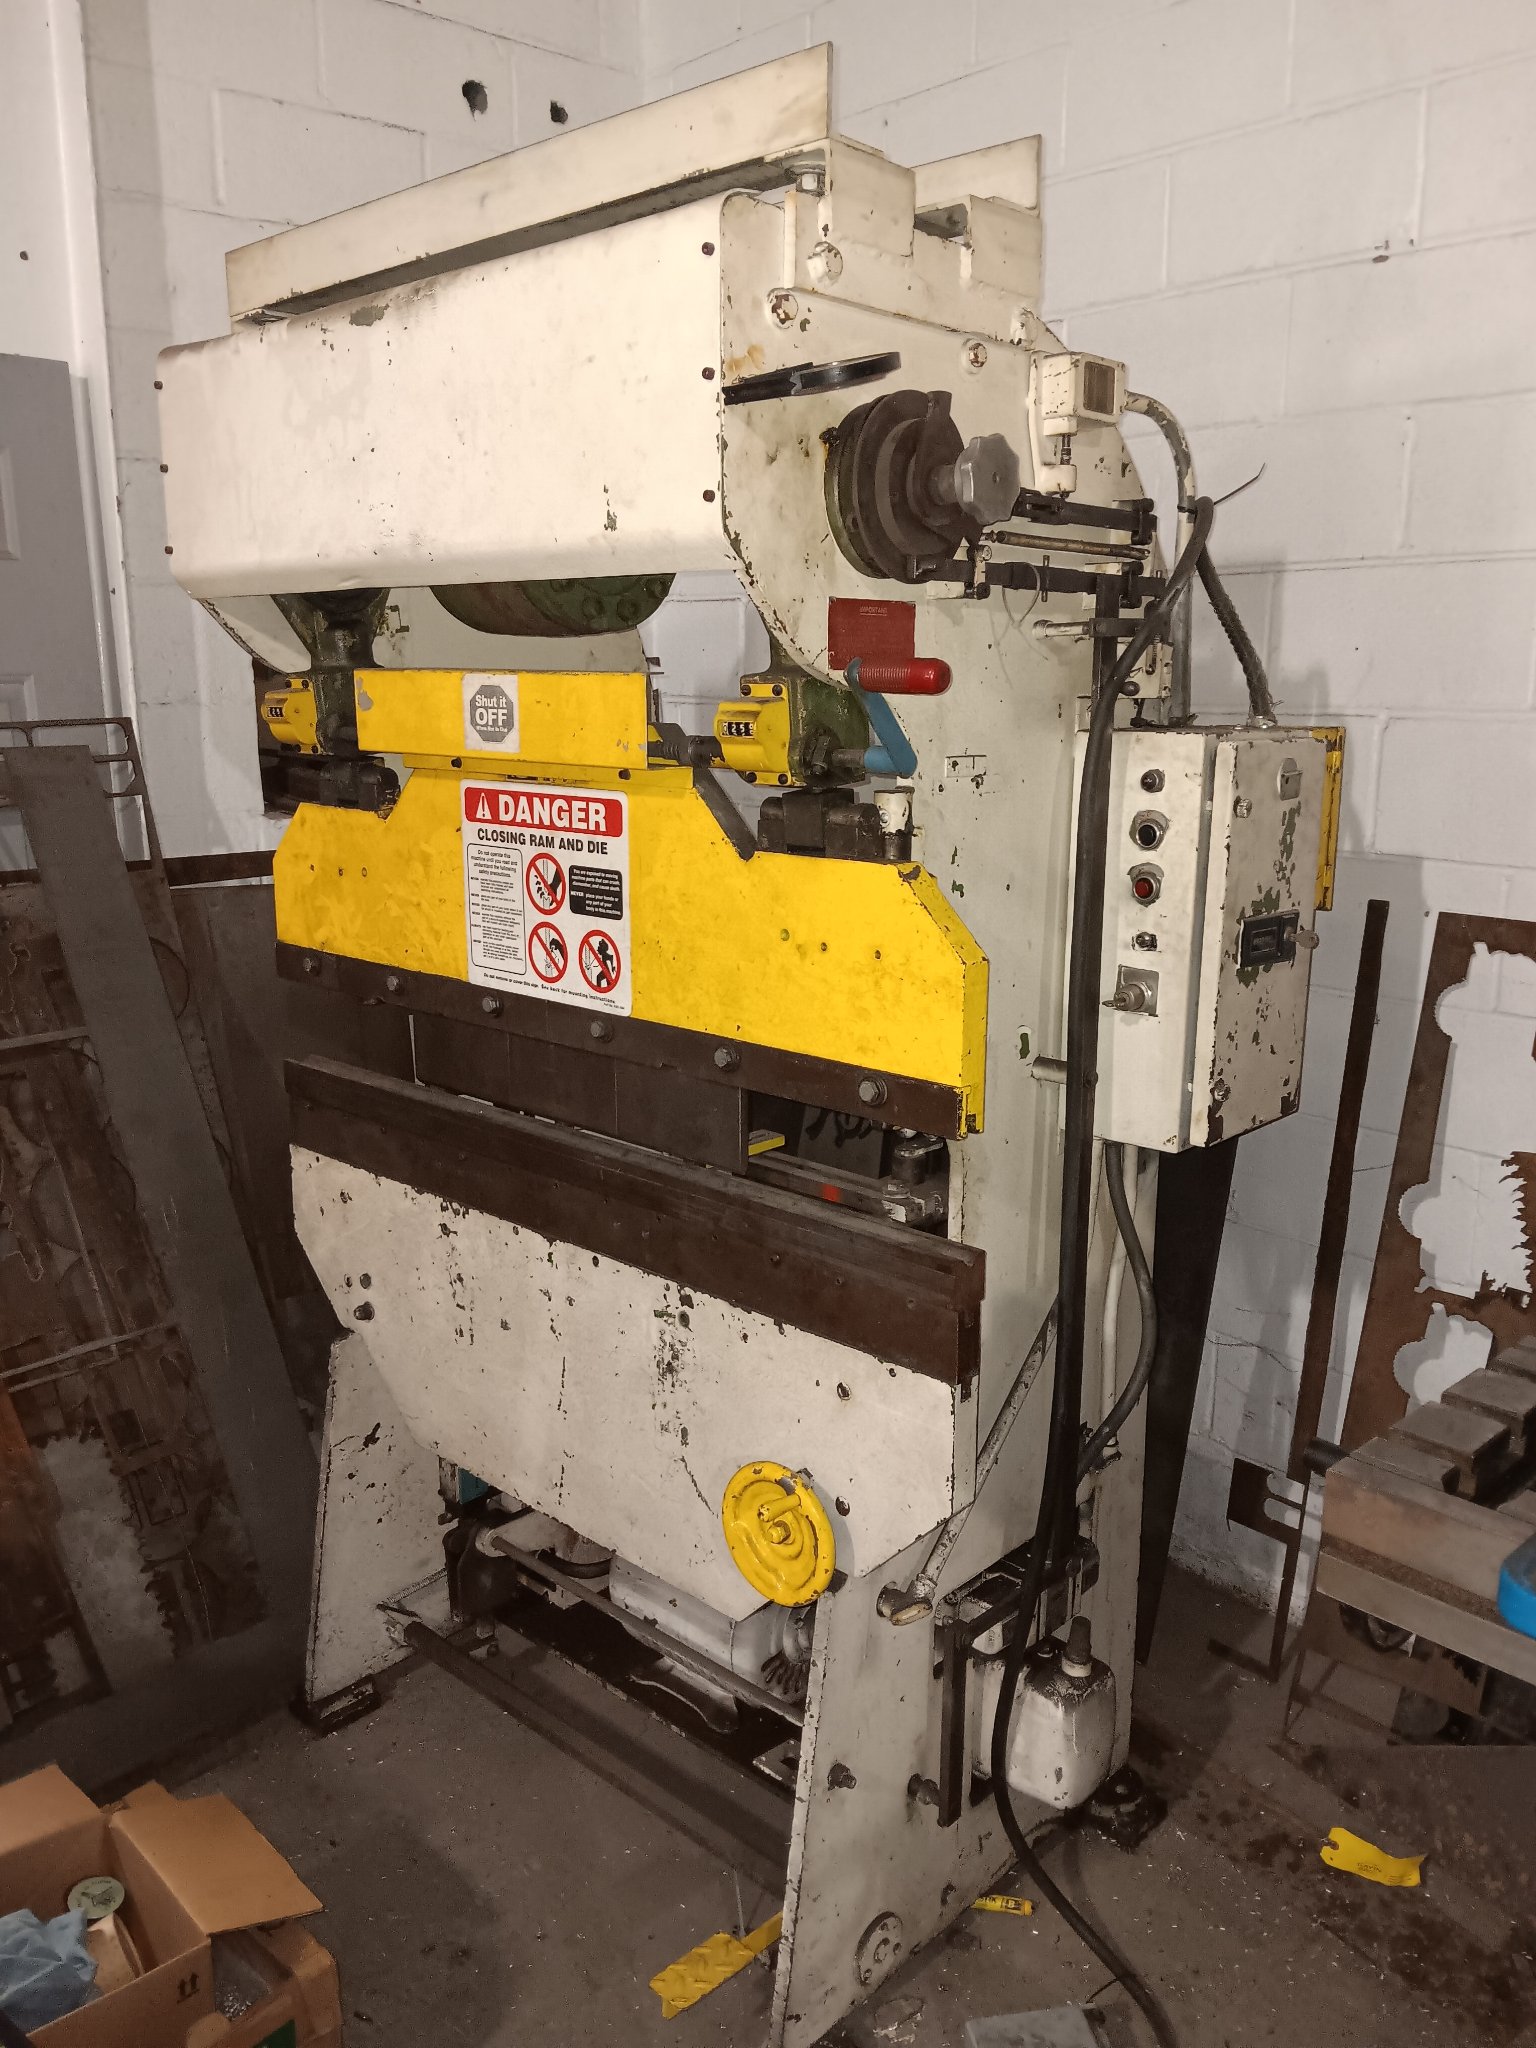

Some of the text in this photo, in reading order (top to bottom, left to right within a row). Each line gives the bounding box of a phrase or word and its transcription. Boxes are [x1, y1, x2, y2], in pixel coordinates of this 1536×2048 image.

[475, 694, 507, 708] Shut it
[475, 707, 507, 726] OFF
[498, 794, 607, 832] DANGER
[477, 828, 608, 855] CLOSING RAM AND DIE
